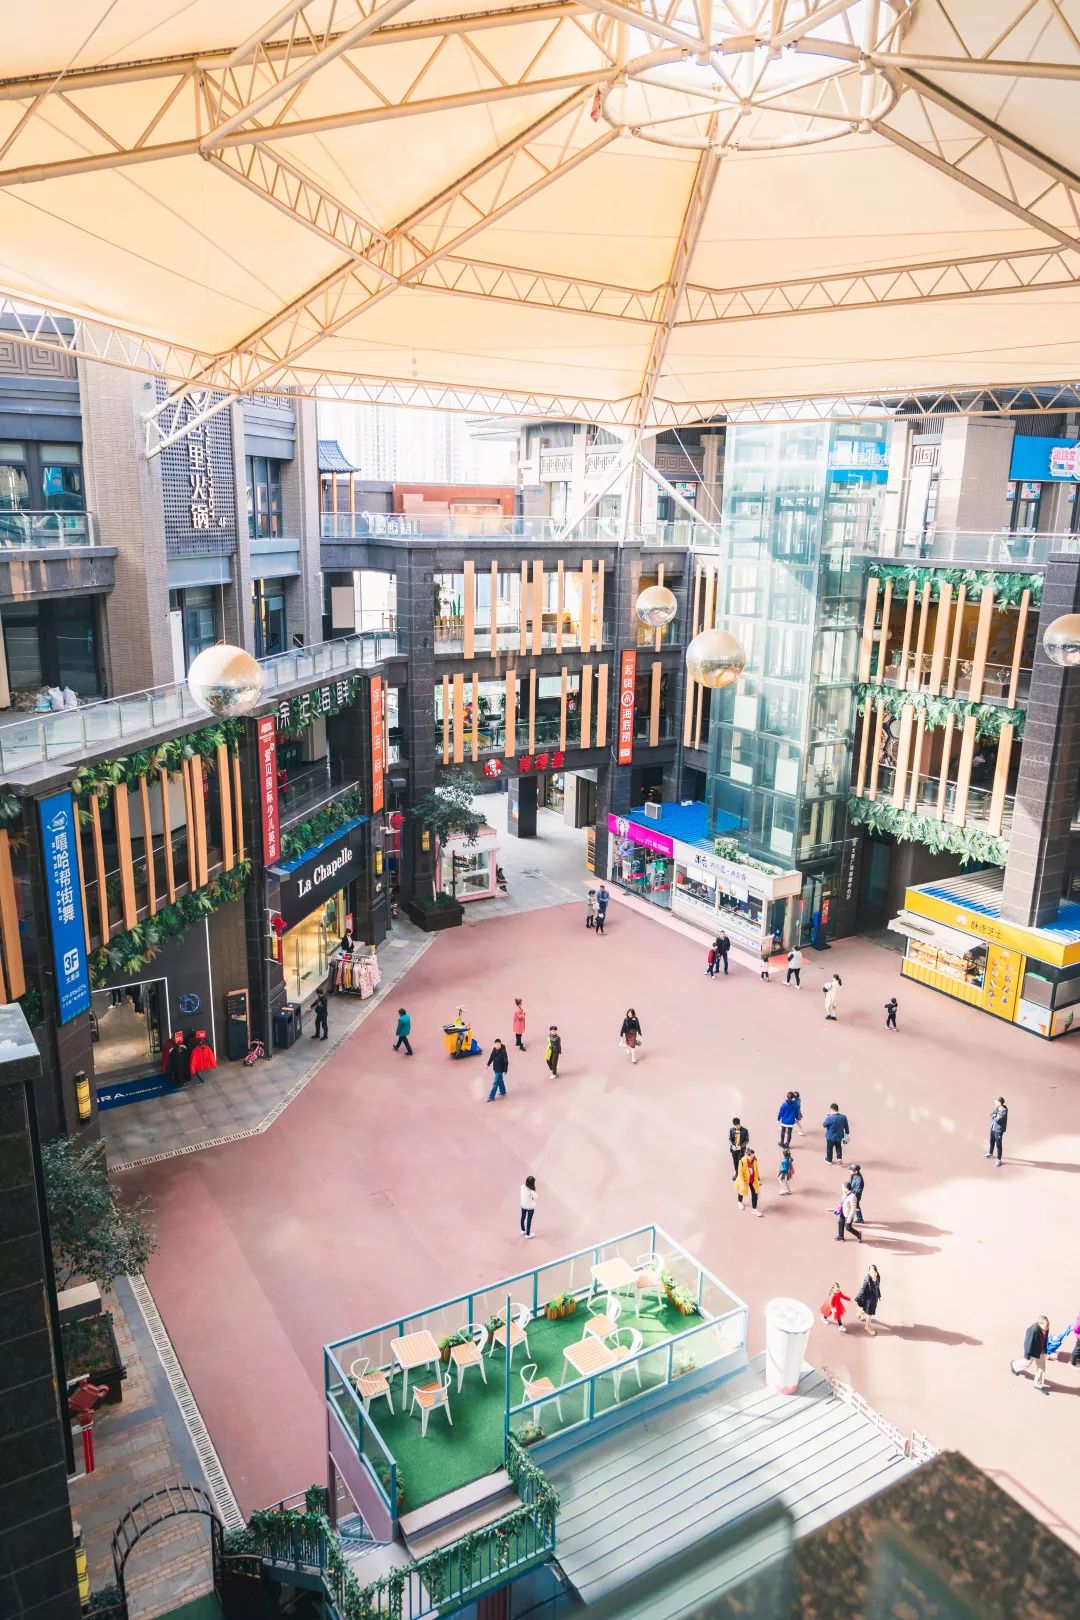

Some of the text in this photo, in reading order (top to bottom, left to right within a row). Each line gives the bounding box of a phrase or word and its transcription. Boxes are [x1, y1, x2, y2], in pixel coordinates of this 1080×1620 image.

[218, 516, 228, 528] 4F
[55, 832, 76, 924] 嘻哈帮街舞
[298, 847, 353, 898] La Chapelle
[64, 952, 78, 971] 3F
